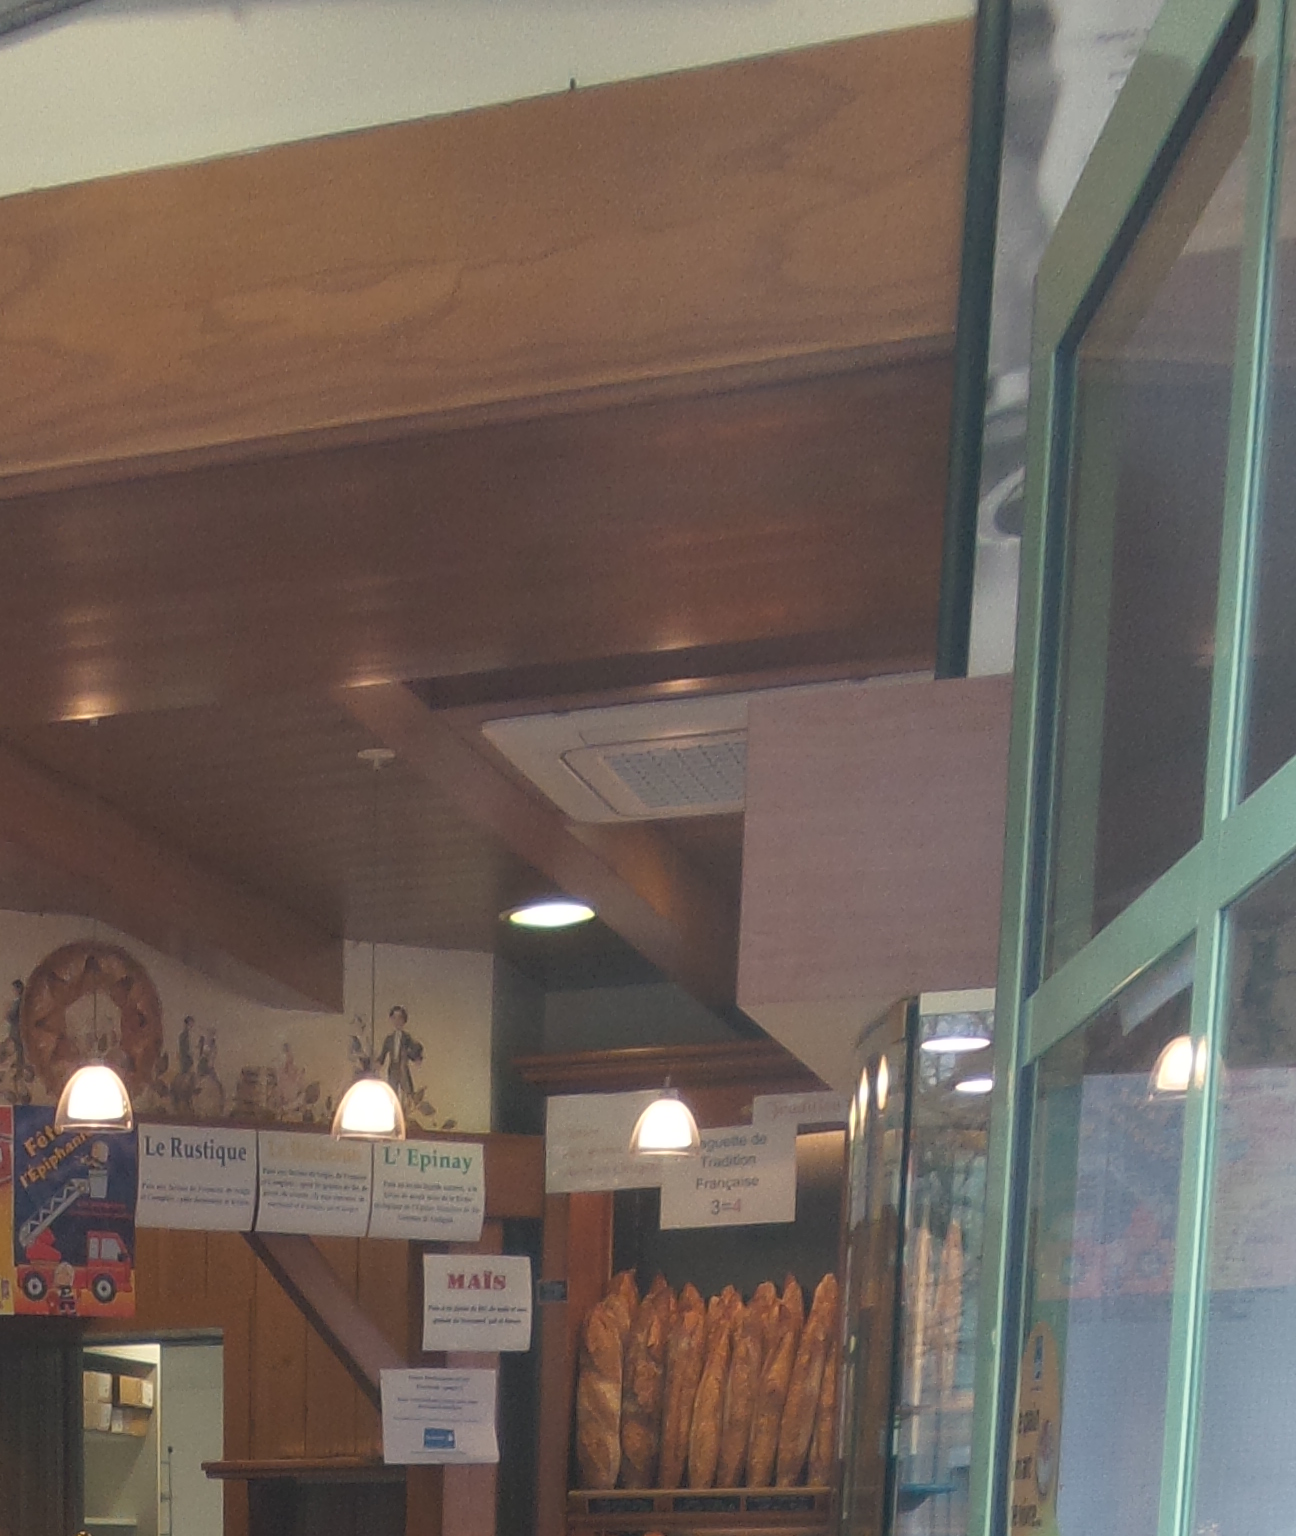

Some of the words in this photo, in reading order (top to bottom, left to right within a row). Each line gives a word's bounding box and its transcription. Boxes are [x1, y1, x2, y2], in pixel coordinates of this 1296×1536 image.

[145, 1136, 165, 1156] Le
[170, 1137, 247, 1167] Rustique
[699, 1135, 746, 1152] aguette
[750, 1134, 767, 1145] de
[384, 1146, 400, 1165] L'
[407, 1148, 472, 1175] Epinay
[701, 1154, 756, 1168] Tradition
[696, 1177, 759, 1191] Française
[711, 1200, 741, 1215] 3=4
[447, 1270, 506, 1290] MAÏS
